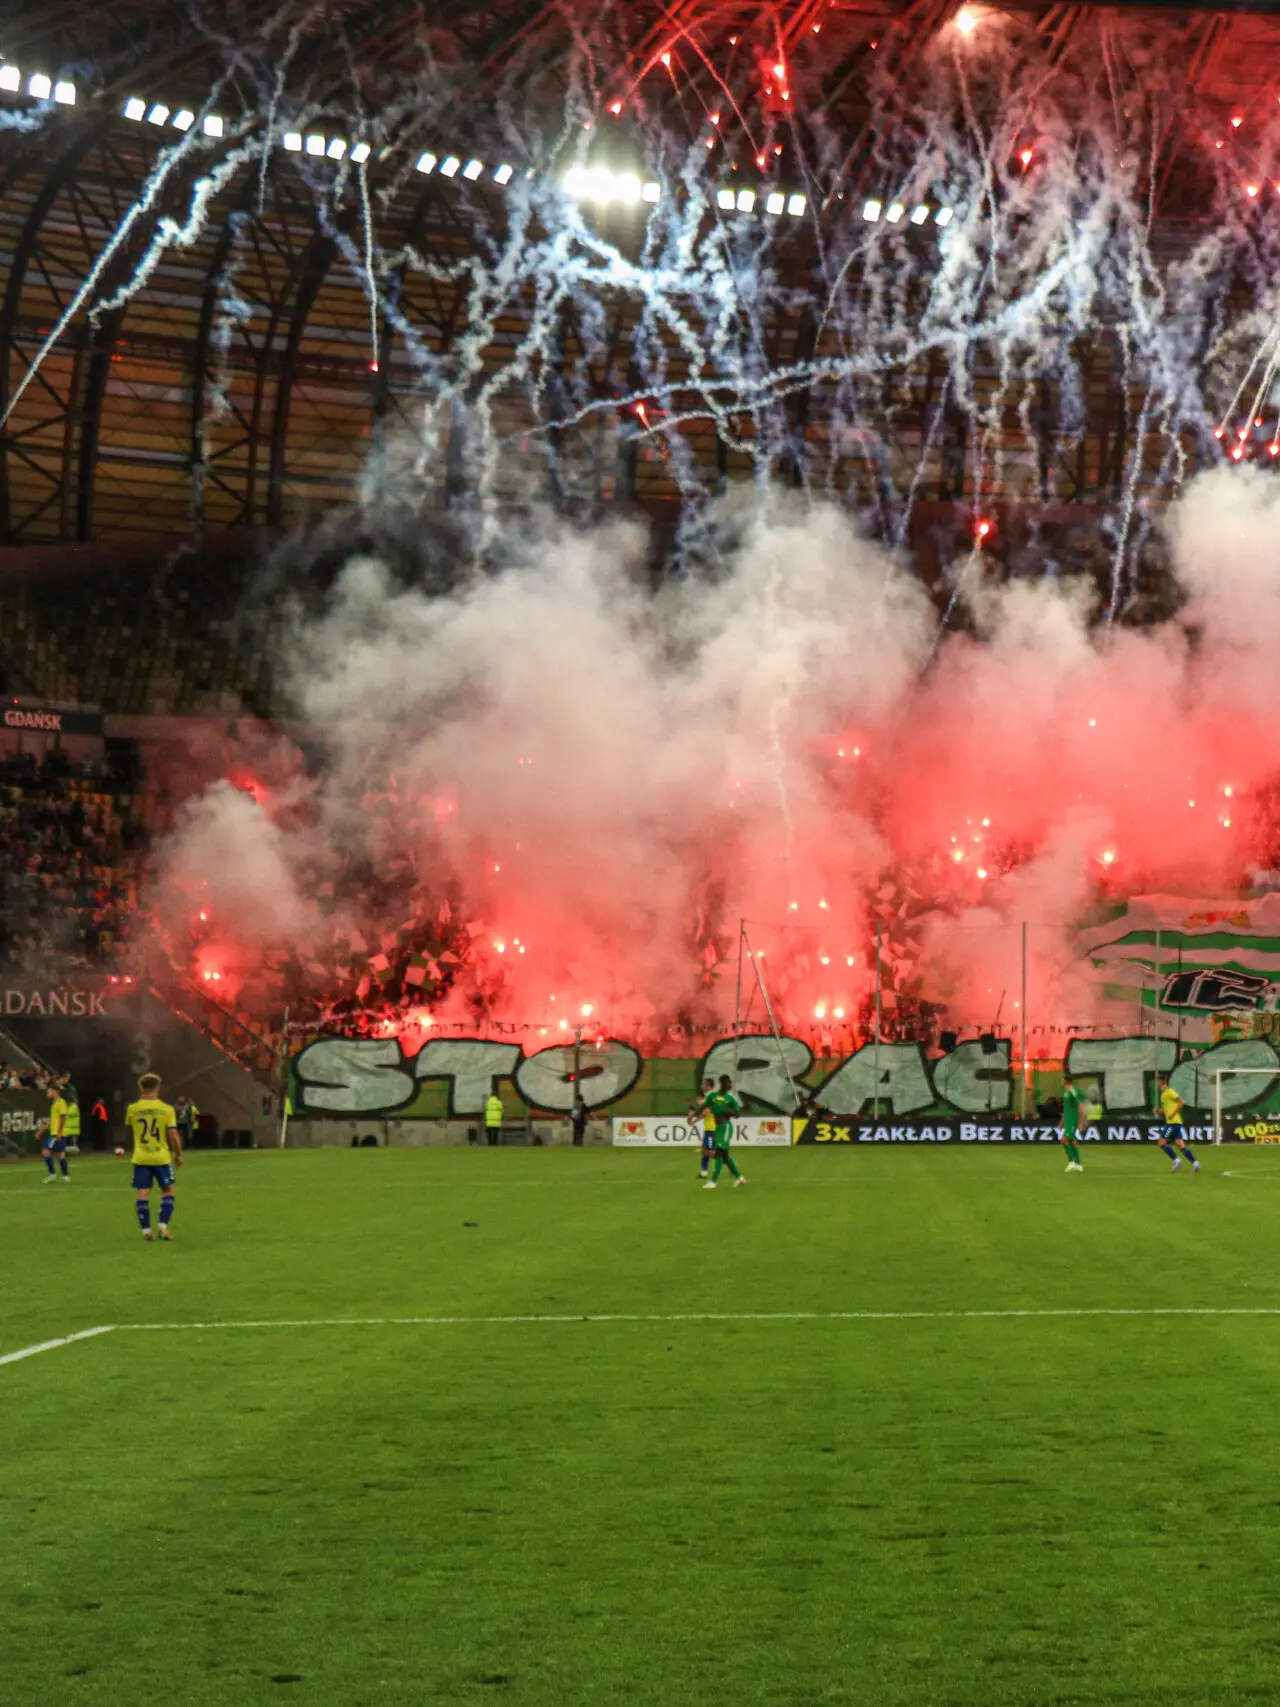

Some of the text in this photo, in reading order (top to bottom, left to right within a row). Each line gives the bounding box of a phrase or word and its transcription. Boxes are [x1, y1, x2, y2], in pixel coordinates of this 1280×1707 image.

[4, 709, 62, 730] GDAŃSK
[0, 985, 107, 1016] DAŃSK
[292, 1036, 643, 1116] STO
[697, 1034, 1013, 1117] RAC
[137, 1117, 161, 1144] 24
[654, 1124, 749, 1142] GDAK
[814, 1123, 851, 1142] 3x
[858, 1125, 953, 1142] ZAKŁAD
[959, 1122, 1004, 1141] BEZ
[1107, 1125, 1142, 1141] NA
[1147, 1125, 1223, 1141] SRT!
